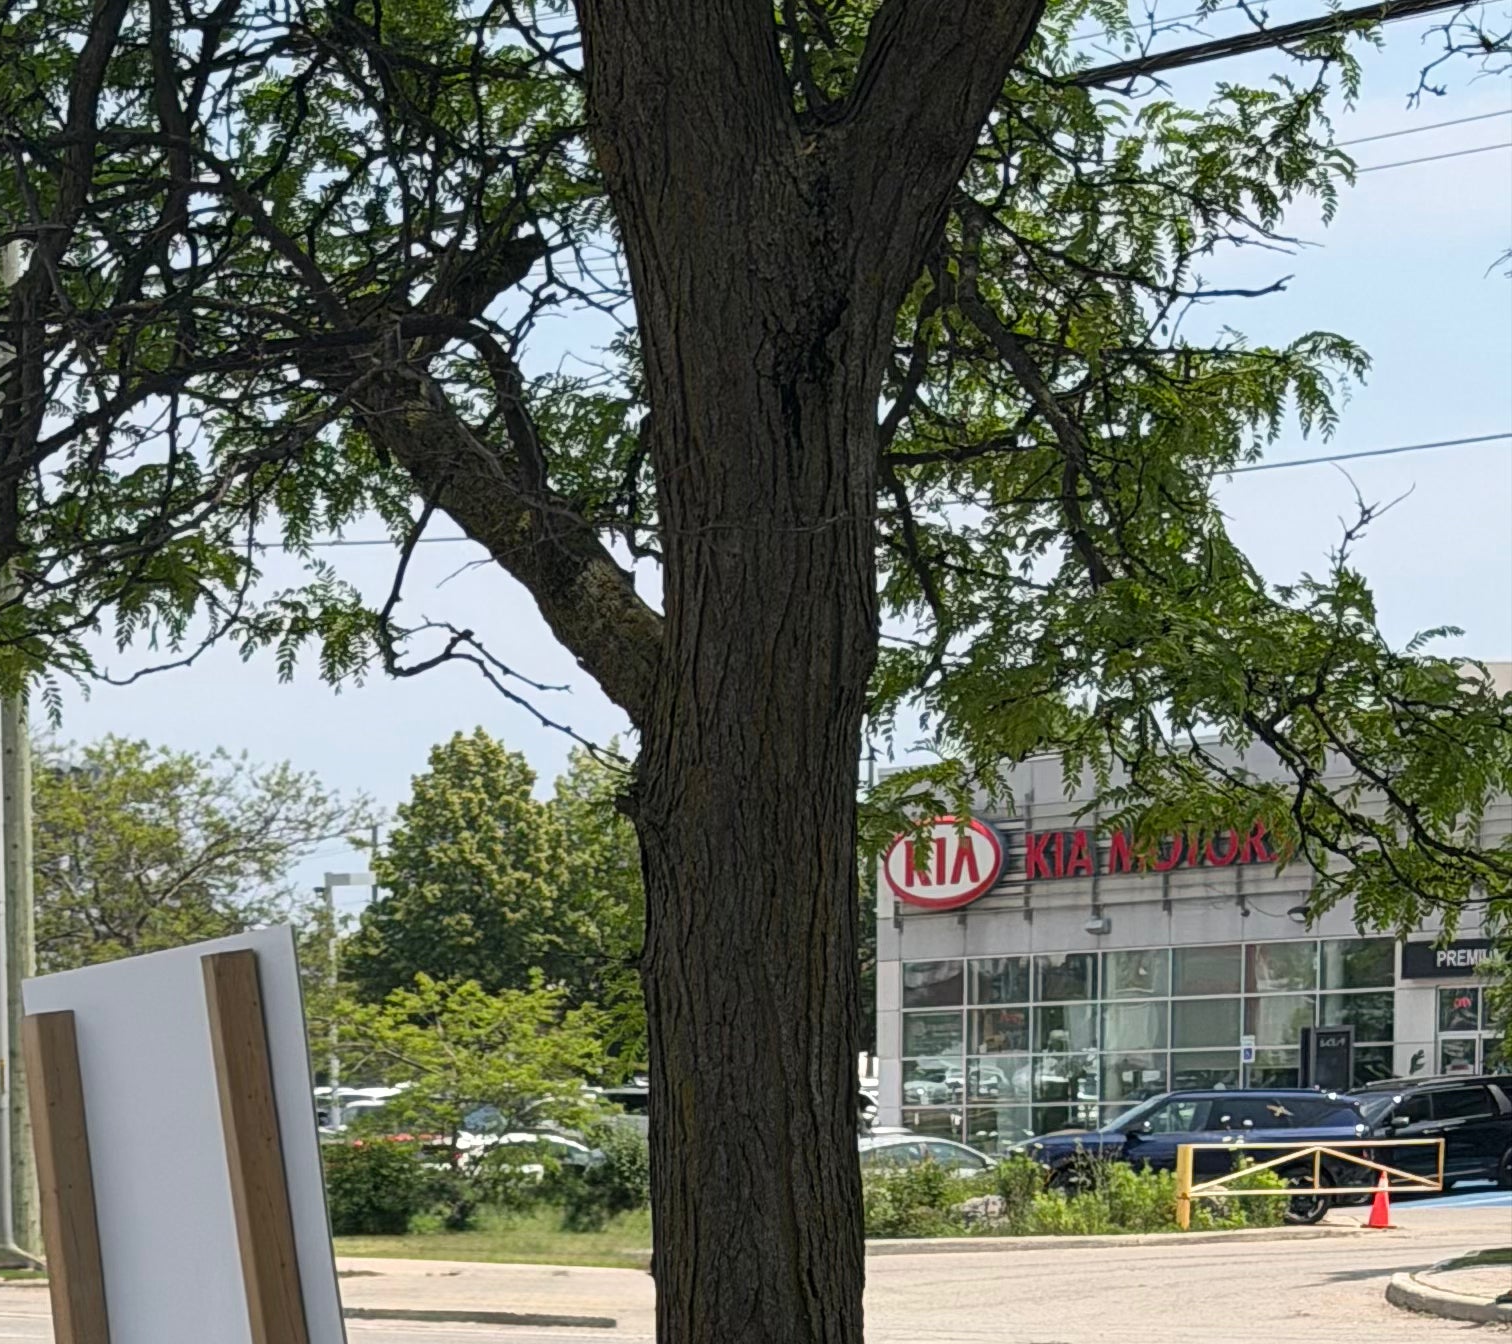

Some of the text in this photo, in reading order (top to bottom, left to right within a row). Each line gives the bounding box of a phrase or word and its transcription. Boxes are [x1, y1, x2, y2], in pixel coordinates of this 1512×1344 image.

[904, 836, 980, 888] KIA
[1025, 813, 1293, 880] KIA MOTOR
